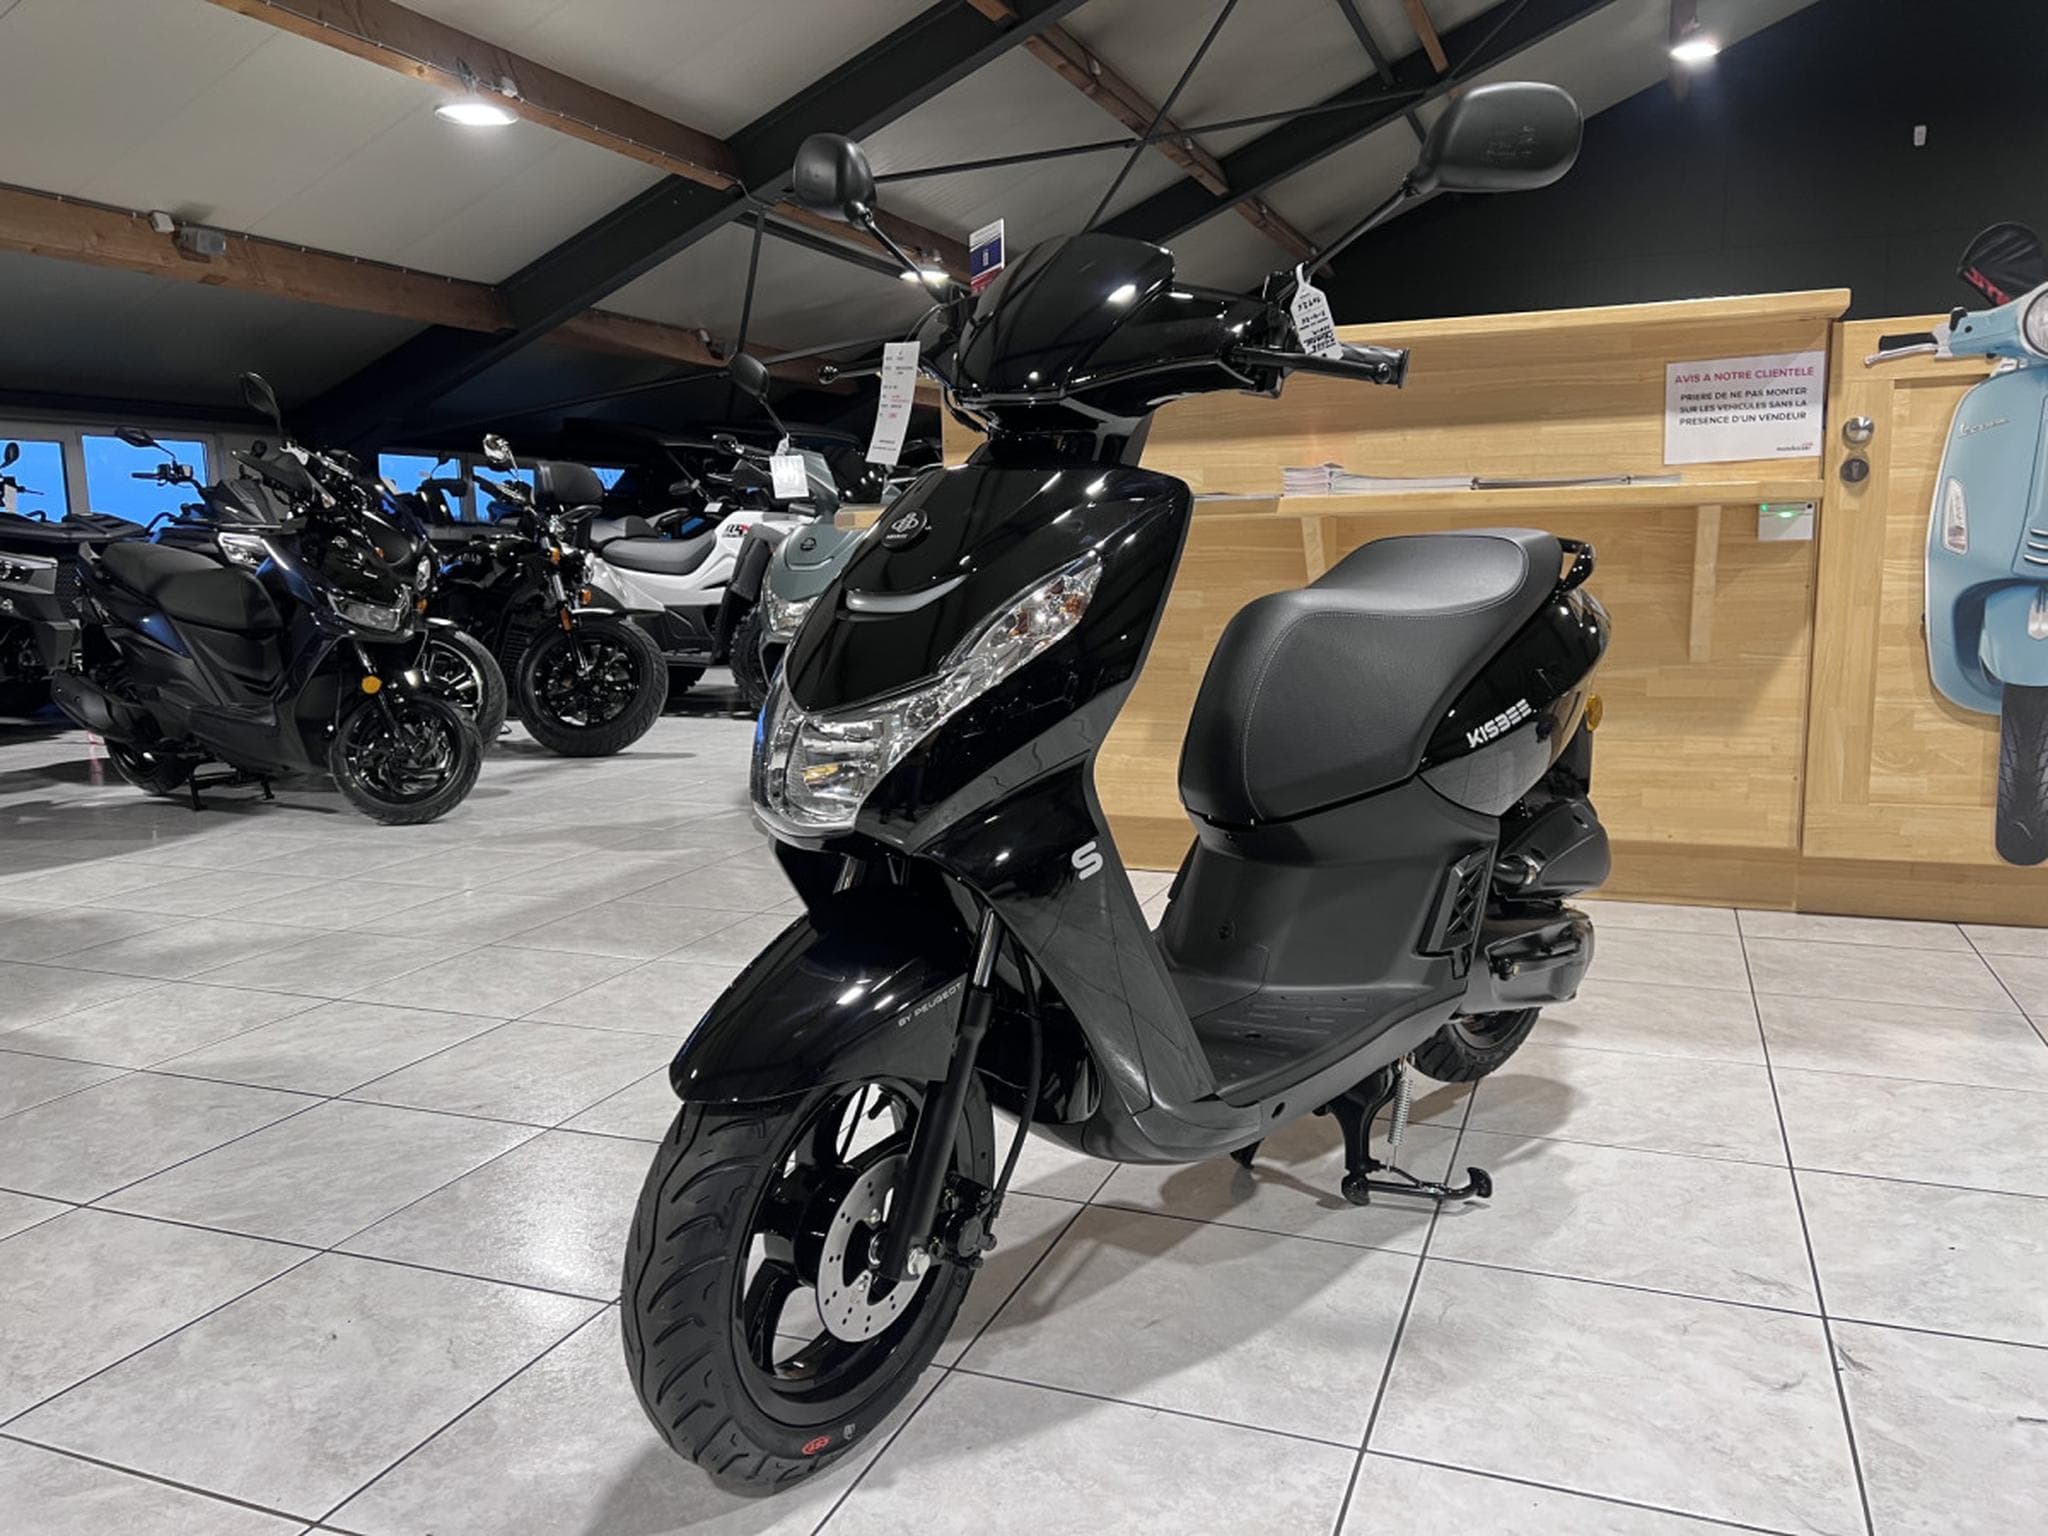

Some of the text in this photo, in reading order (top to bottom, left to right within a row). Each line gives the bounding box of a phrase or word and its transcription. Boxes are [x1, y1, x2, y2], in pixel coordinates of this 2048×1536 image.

[1675, 366, 1814, 383] AVIS A NOTRE CLIENTELE
[1680, 386, 1807, 401] PRIERE DE NE PAS MONTER
[1680, 399, 1807, 413] SUR LES VEHICULES SANS LA
[1680, 411, 1807, 426] PRESENCE D'UN VENDEUR
[898, 982, 961, 1027] BY PEUGEOT
